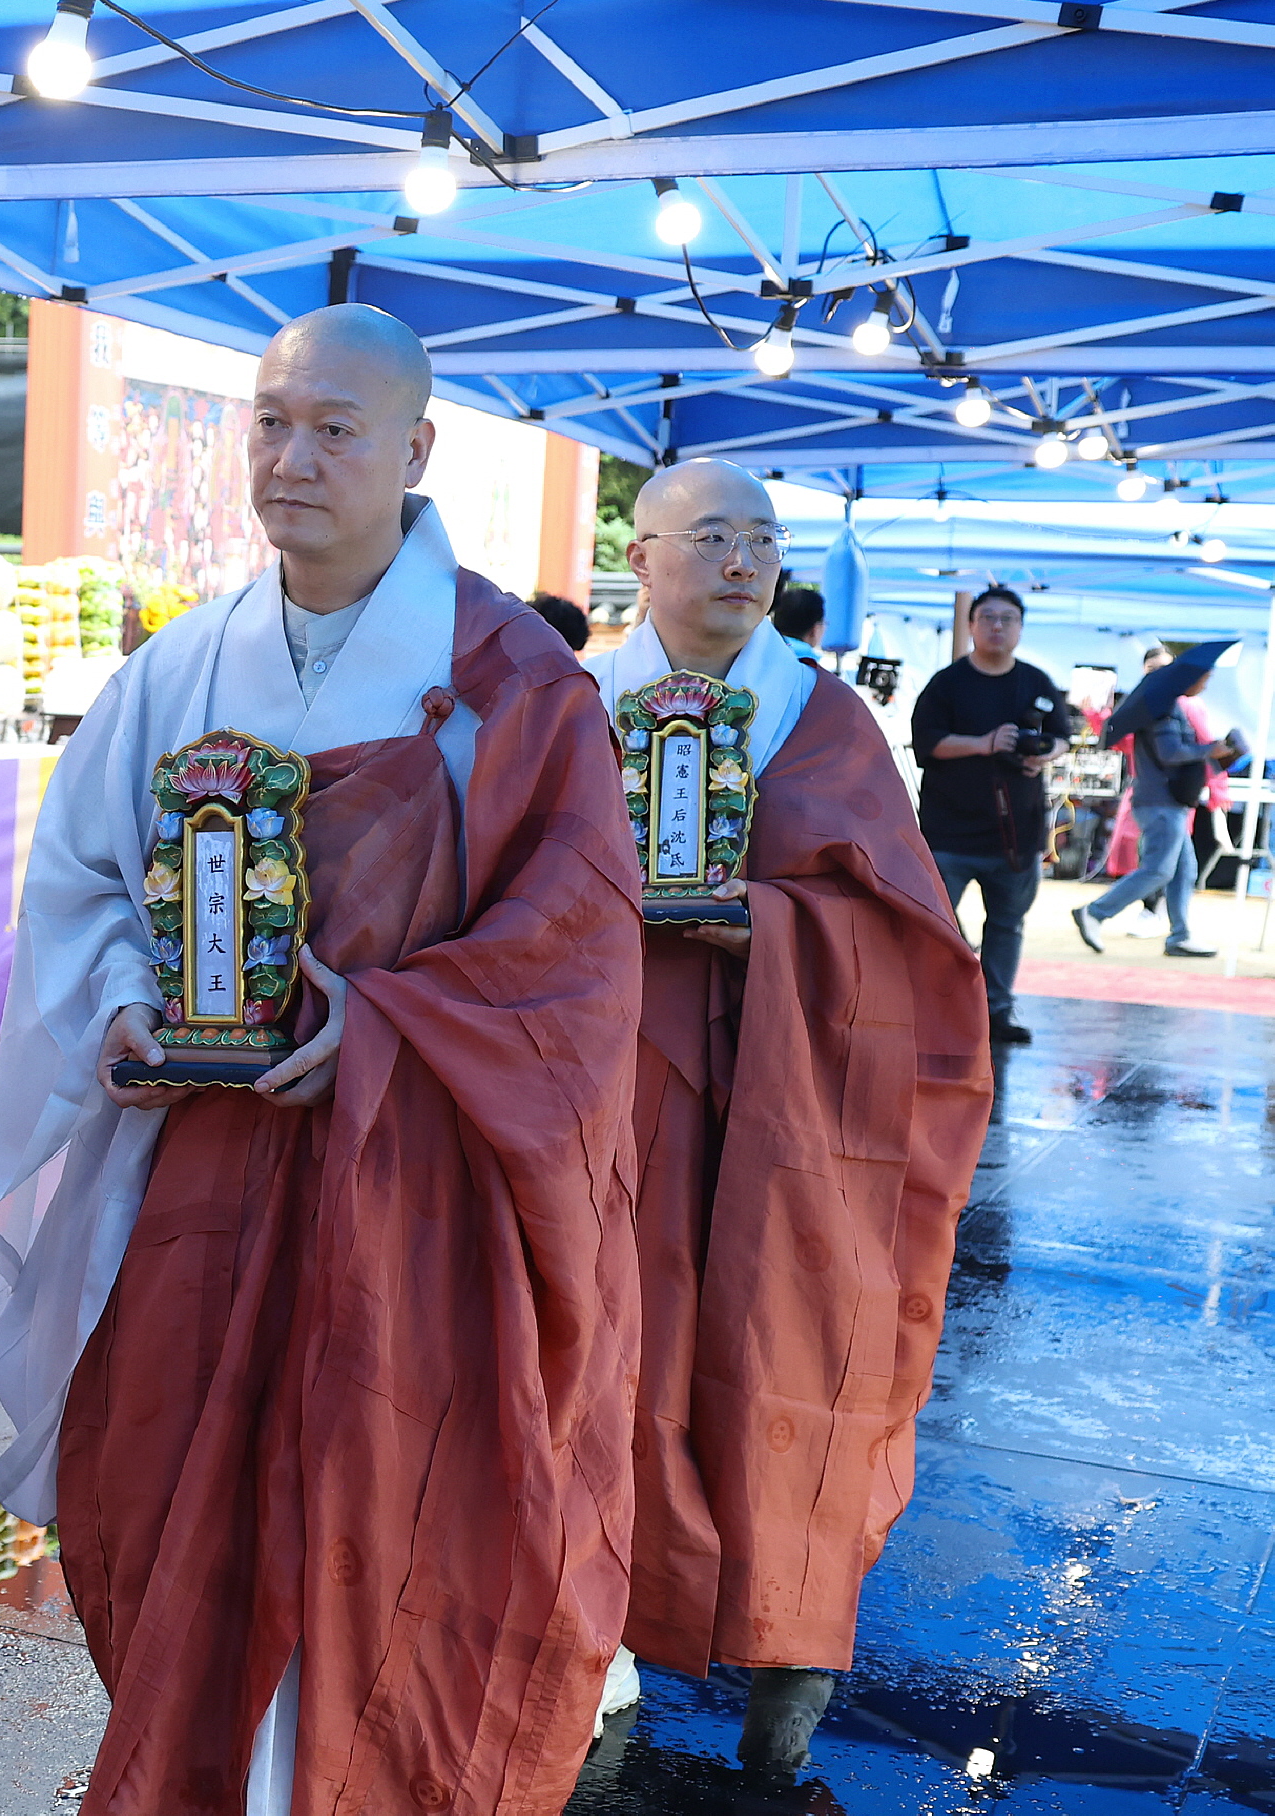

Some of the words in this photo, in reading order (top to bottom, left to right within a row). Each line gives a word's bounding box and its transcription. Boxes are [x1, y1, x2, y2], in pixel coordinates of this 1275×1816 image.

[670, 744, 691, 867] 昭憲王后沈氏
[207, 854, 226, 992] 世宗大王
